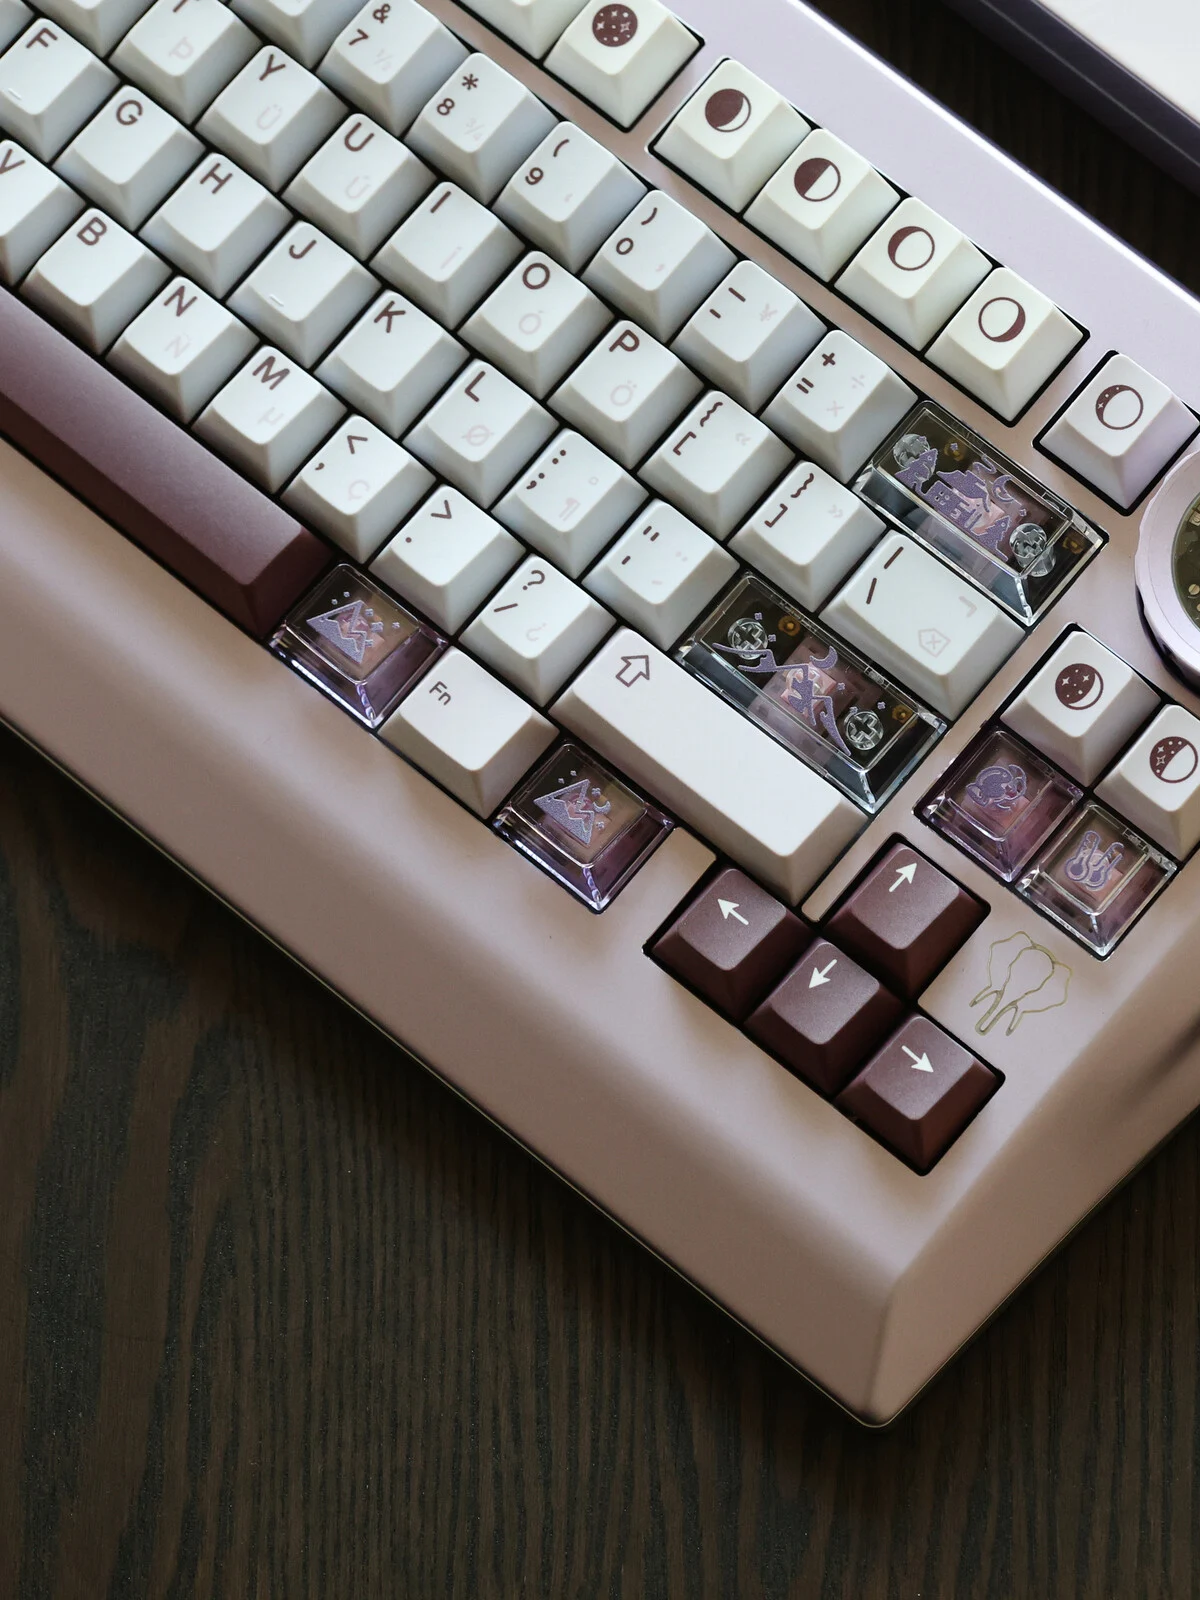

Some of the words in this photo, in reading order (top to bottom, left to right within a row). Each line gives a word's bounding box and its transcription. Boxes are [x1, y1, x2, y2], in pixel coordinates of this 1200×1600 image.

[373, 4, 390, 23] &
[27, 28, 57, 48] F
[349, 29, 368, 45] 7
[259, 54, 286, 81] Y
[116, 100, 142, 125] G
[437, 98, 455, 115] 8
[344, 122, 374, 152] U
[553, 139, 569, 157] (
[0, 149, 25, 174] V
[200, 163, 232, 193] H
[525, 167, 543, 185] 9
[431, 191, 451, 213] I
[641, 208, 657, 225] )
[77, 217, 106, 245] B
[289, 240, 316, 259] J
[522, 263, 550, 289] O
[164, 286, 196, 316] N
[374, 301, 406, 333] K
[609, 330, 639, 352] P
[822, 353, 835, 366] +
[253, 356, 289, 389] M
[465, 371, 485, 402] L
[347, 435, 368, 454] <
[673, 431, 696, 455] [
[431, 500, 452, 519] >
[764, 504, 788, 528] ]
[523, 570, 545, 590] ?
[494, 603, 518, 612] /
[429, 681, 451, 705] Fn
